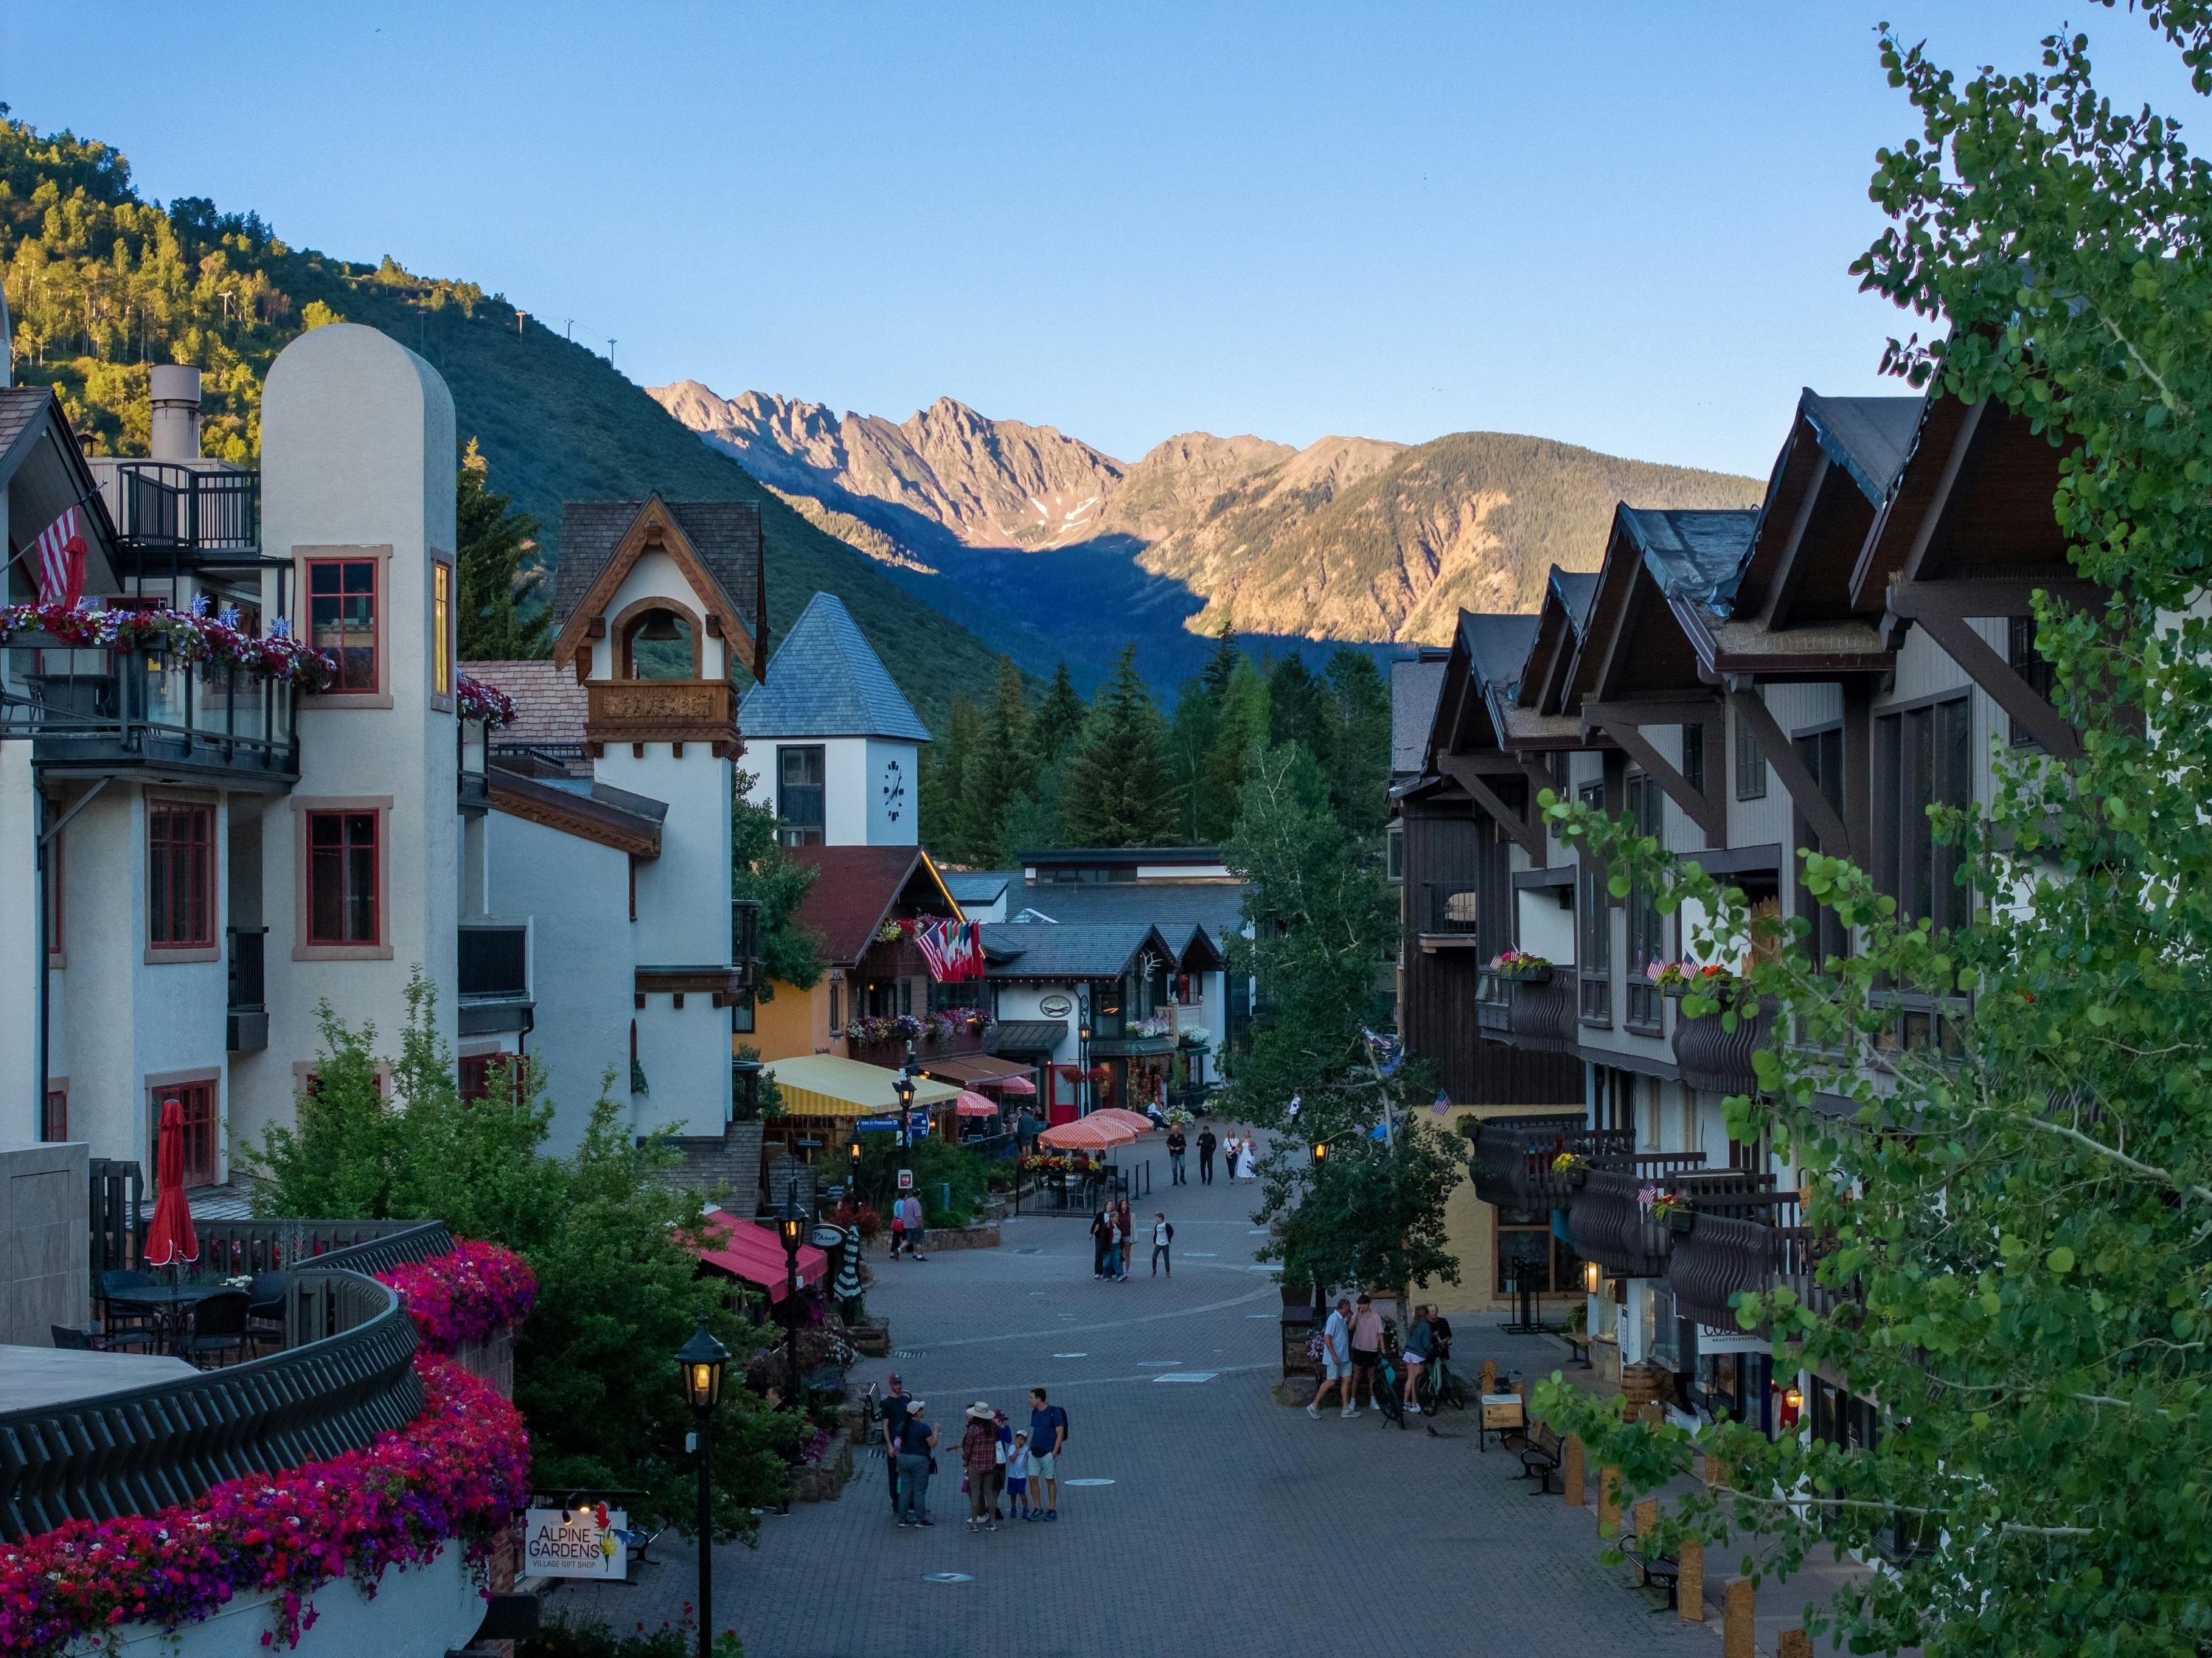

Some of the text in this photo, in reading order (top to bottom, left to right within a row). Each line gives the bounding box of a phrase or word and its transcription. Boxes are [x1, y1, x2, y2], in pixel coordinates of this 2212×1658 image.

[538, 1525, 591, 1543] ALPINE
[529, 1540, 599, 1558] GARDENS
[533, 1559, 560, 1568] VILLAGE
[577, 1561, 596, 1569] SHOP
